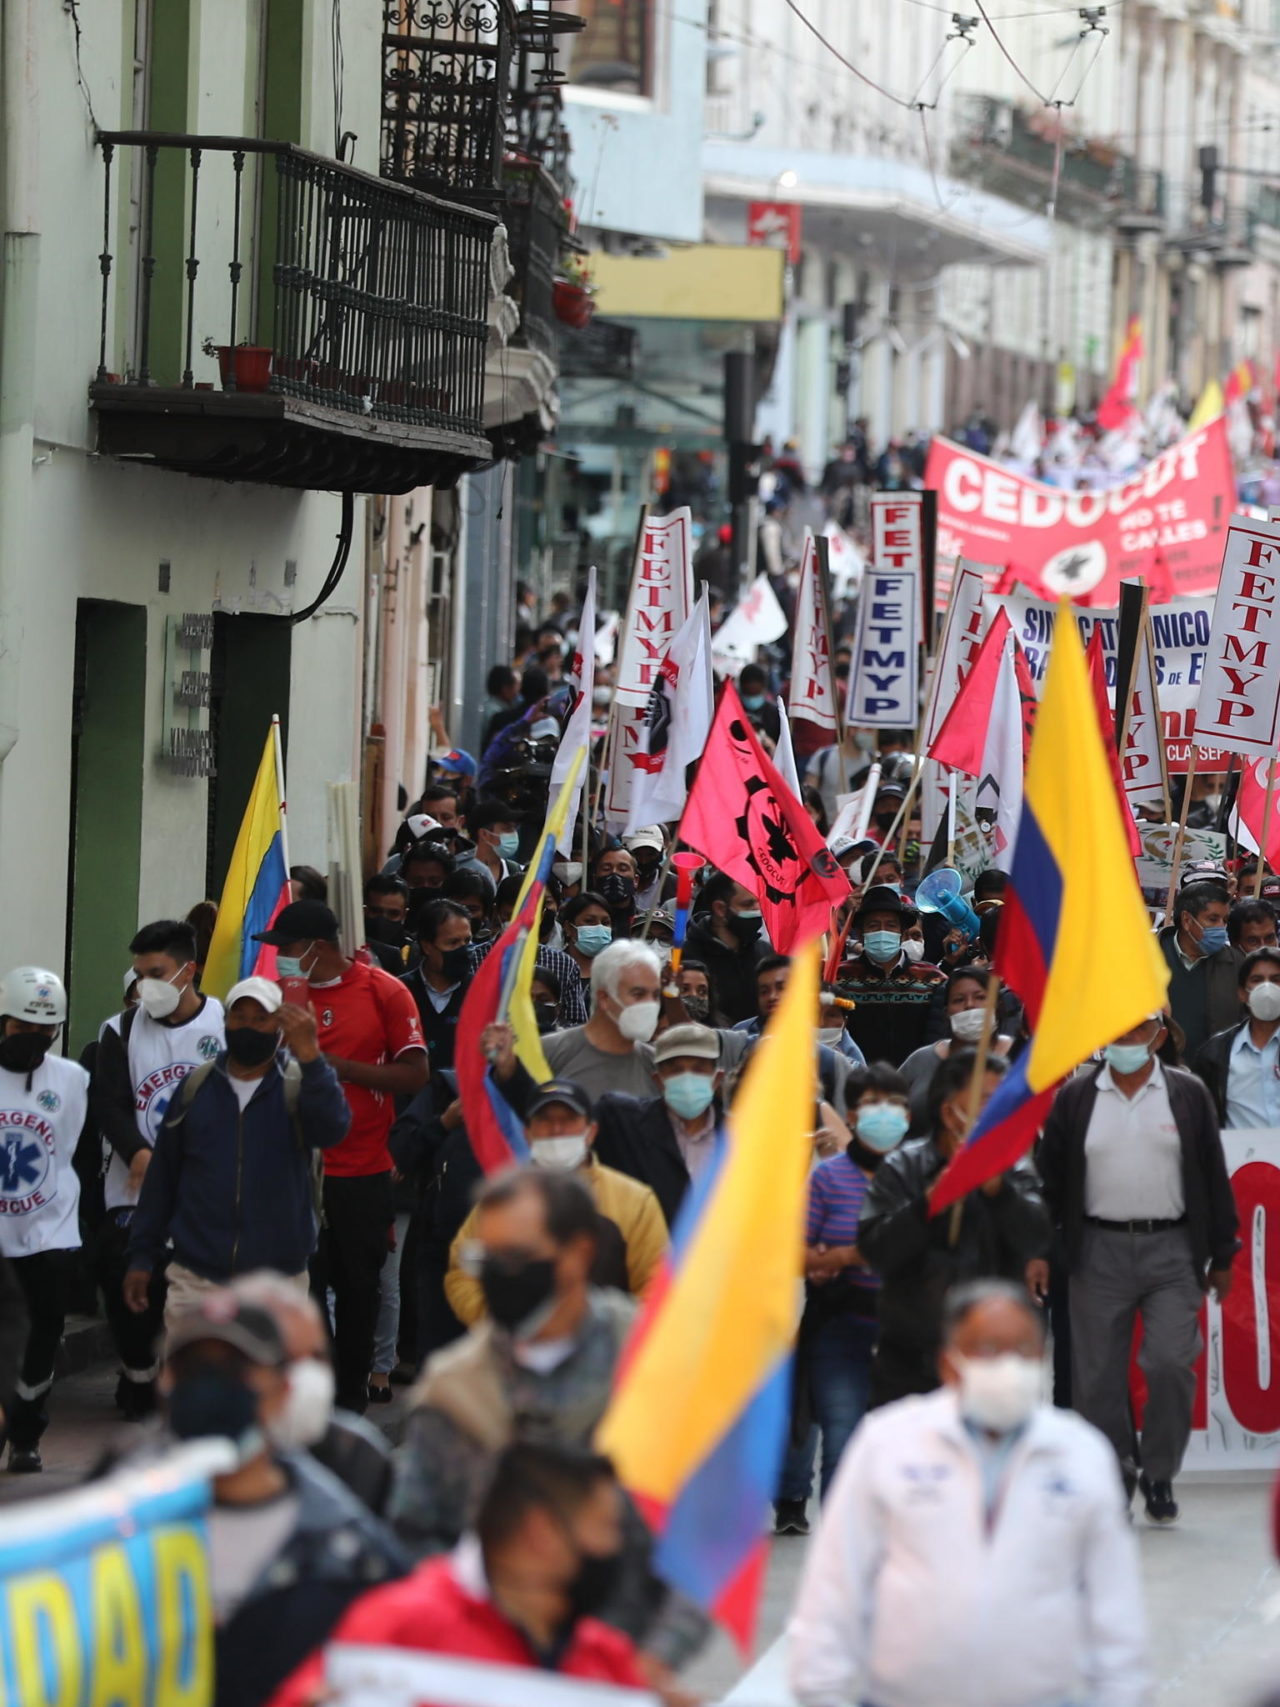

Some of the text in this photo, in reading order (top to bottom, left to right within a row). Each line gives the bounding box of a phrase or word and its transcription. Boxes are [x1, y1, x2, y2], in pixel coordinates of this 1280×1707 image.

[1155, 498, 1187, 521] TE
[1150, 610, 1210, 650] NICO
[863, 579, 905, 715] FETMYP
[1168, 672, 1183, 685] DE
[1167, 745, 1192, 761] CLA
[0, 1191, 45, 1214] SCUE
[0, 1522, 215, 1707] DAD
